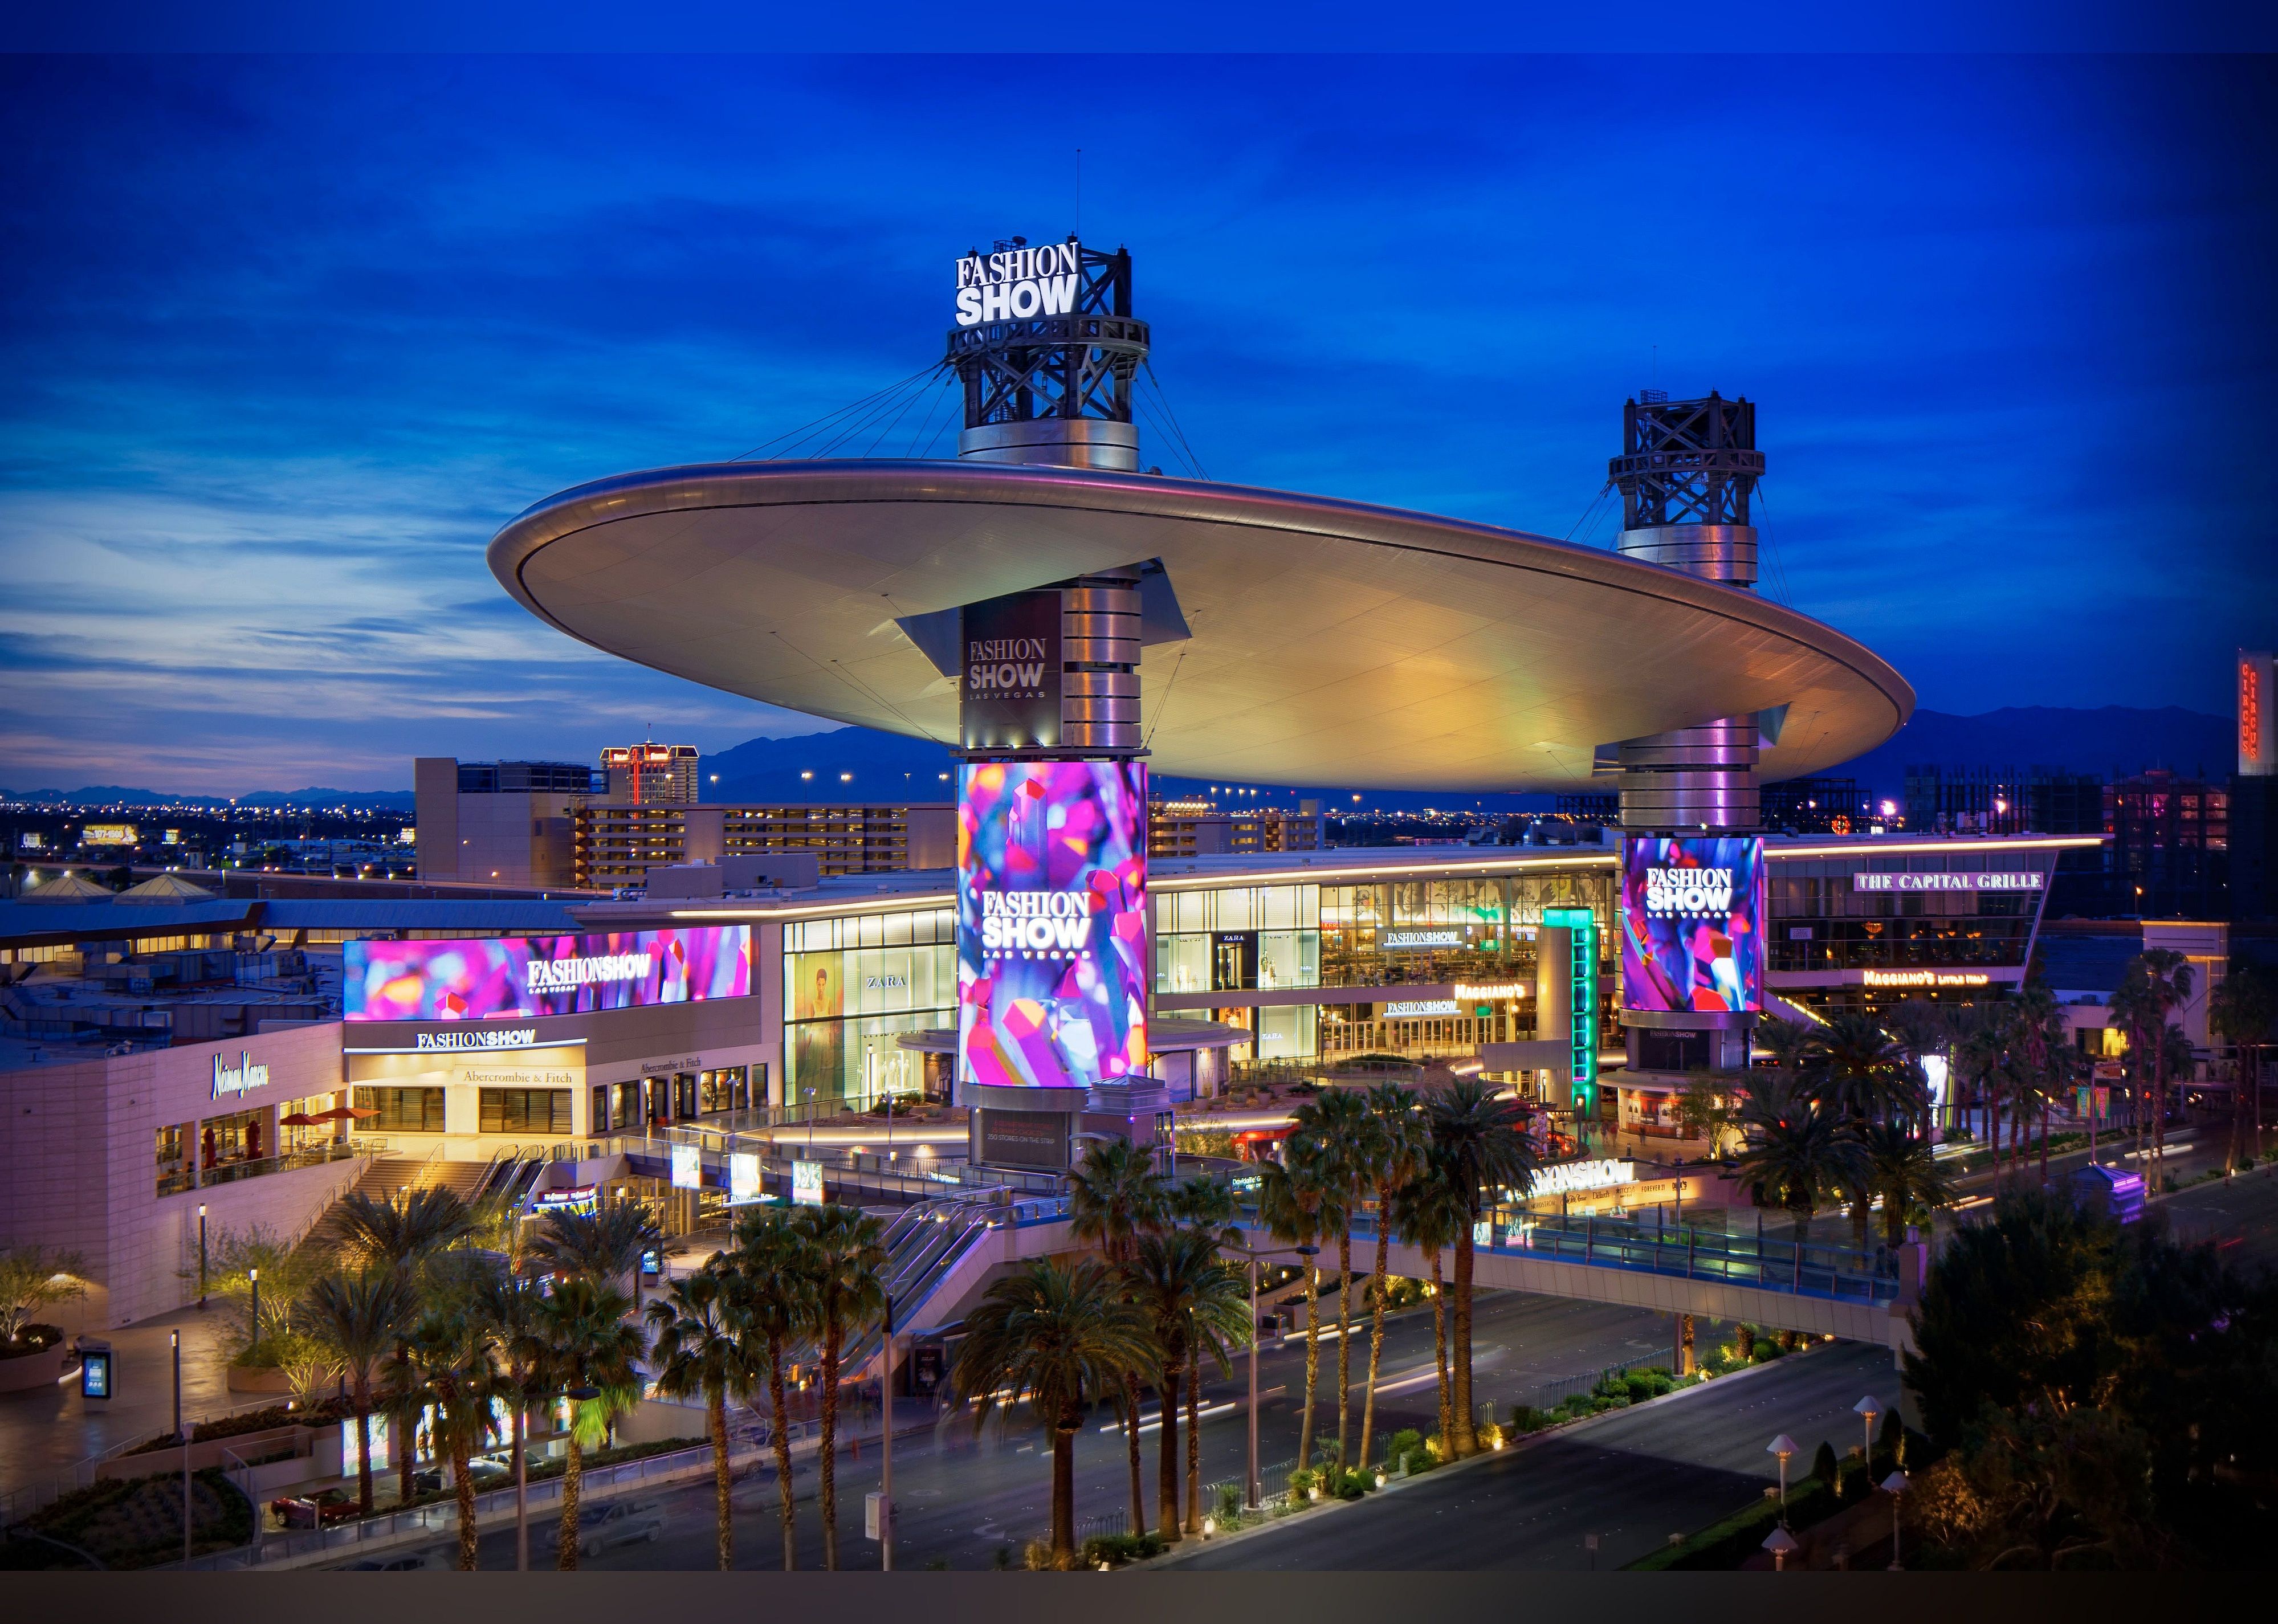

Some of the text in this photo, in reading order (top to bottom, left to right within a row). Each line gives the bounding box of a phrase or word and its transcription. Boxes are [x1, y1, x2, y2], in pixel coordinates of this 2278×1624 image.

[956, 242, 1078, 289] FASHION
[956, 274, 1078, 326] SHOW
[969, 638, 1048, 662] FASHION
[970, 663, 1045, 689] SHOW
[1646, 868, 1732, 887] FASHION
[1857, 874, 2041, 889] THE CAPITAL GRILLE
[982, 891, 1090, 917] FASHION
[1646, 887, 1733, 911] SHOW
[982, 917, 1091, 949] SHOW
[1022, 950, 1091, 960] VEGAS
[867, 976, 906, 989] ZARA
[1864, 971, 1935, 985] MAGGIANO'S
[1454, 984, 1526, 999] MAGGIANO'S
[641, 1060, 678, 1074] Abercrombie
[686, 1057, 701, 1068] Fitch
[464, 1071, 572, 1083] Abercrombie & Fitch
[1672, 1180, 1687, 1190] DK'S
